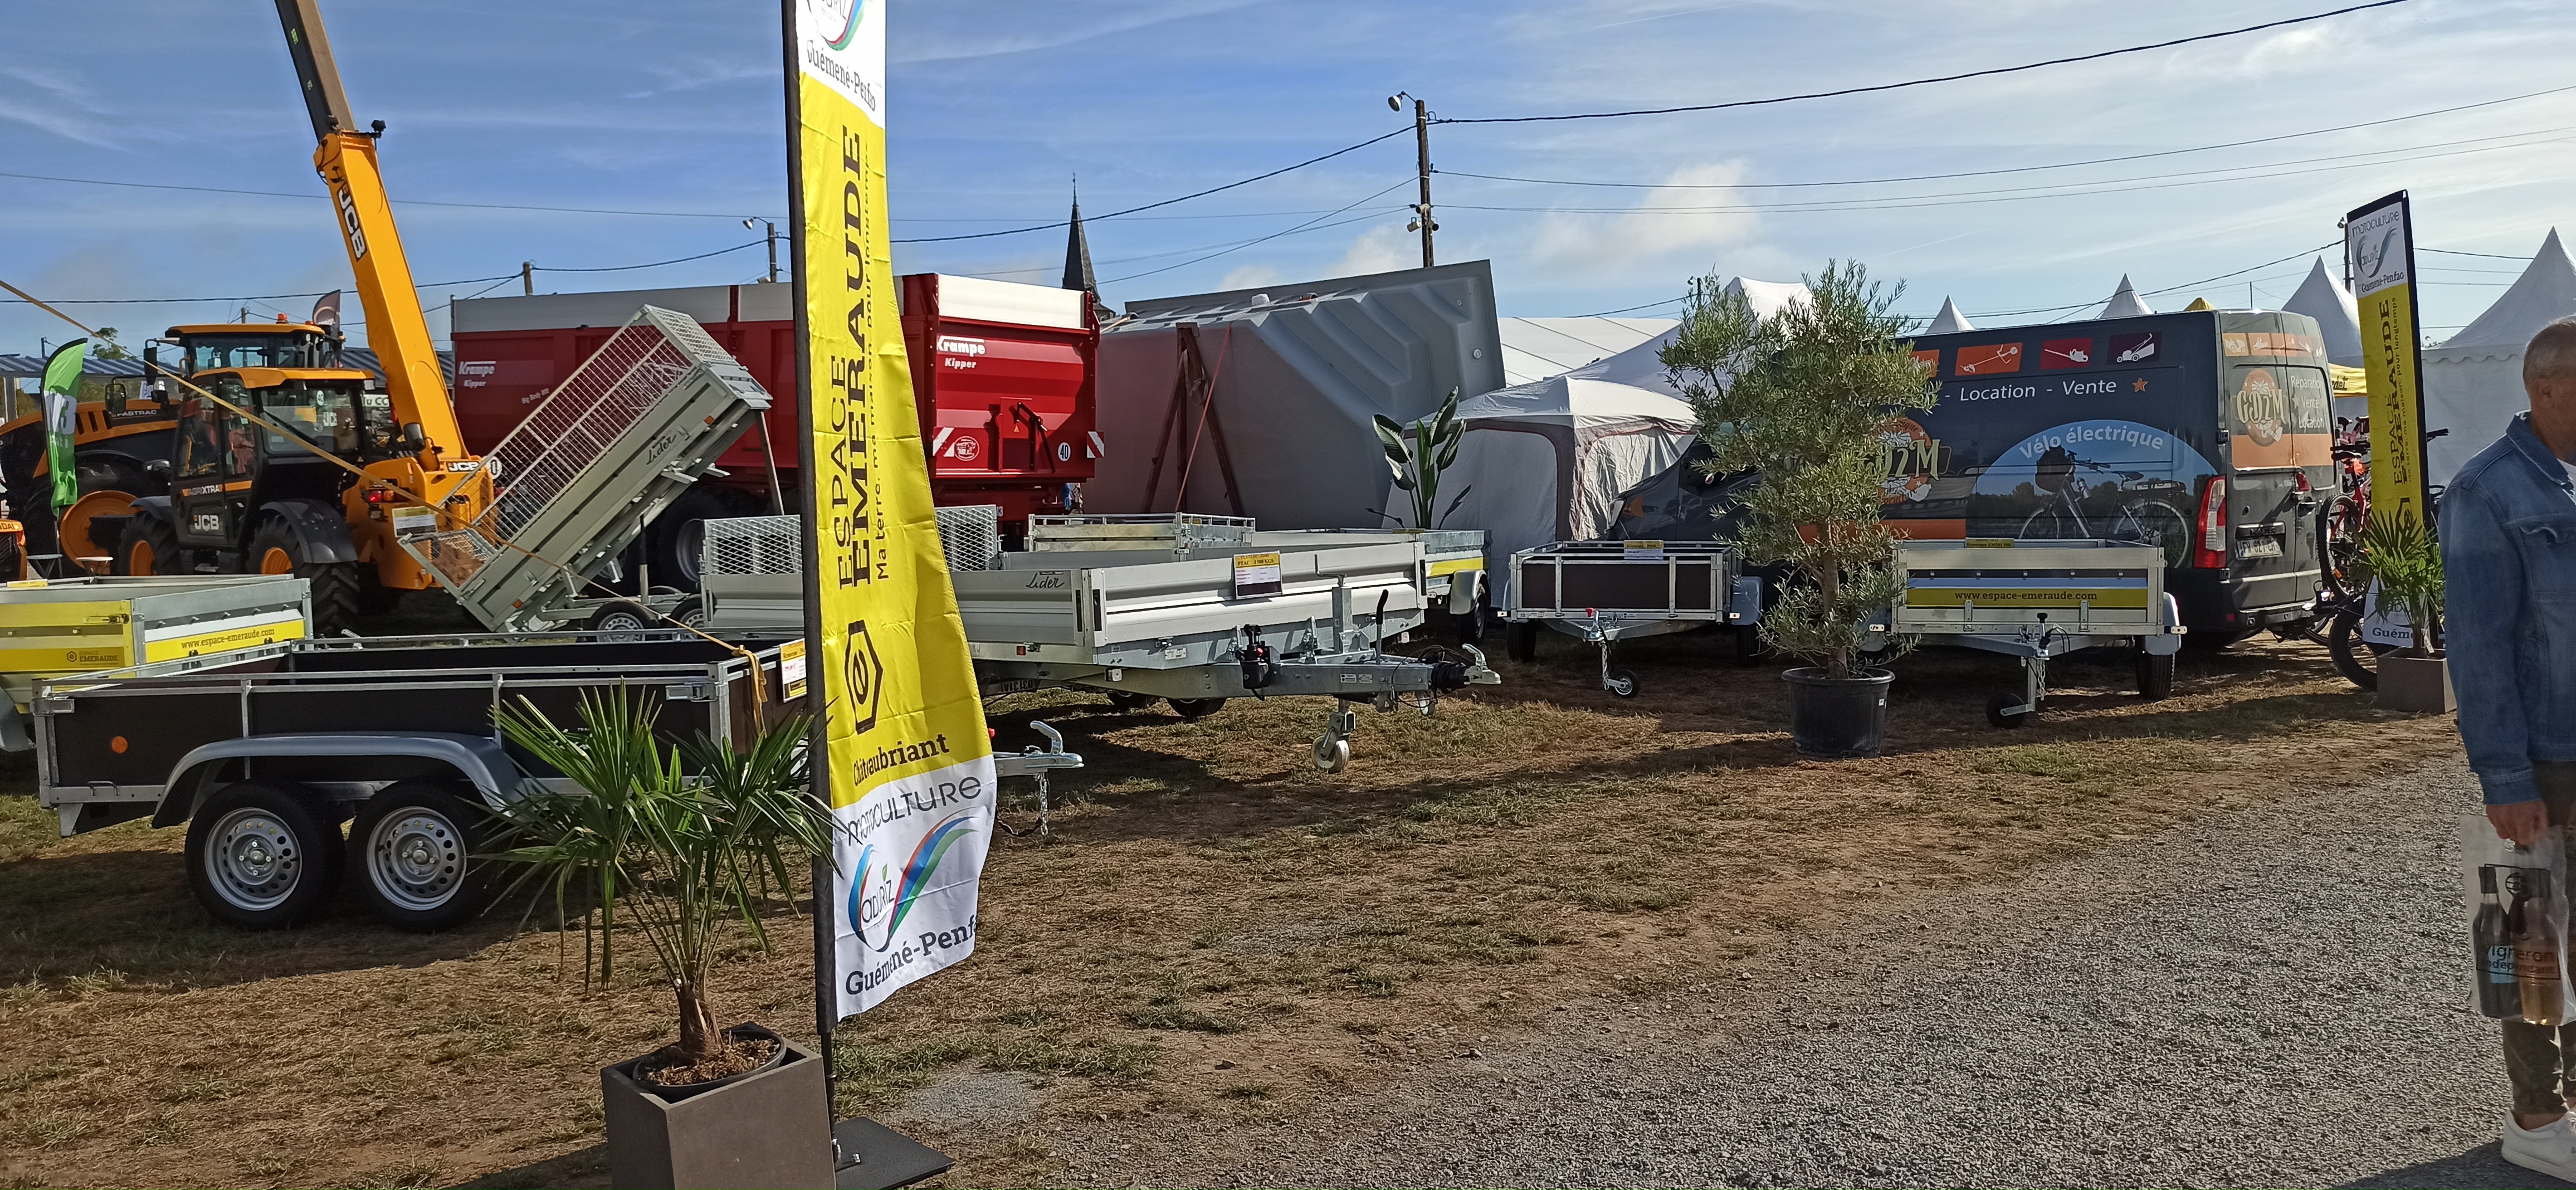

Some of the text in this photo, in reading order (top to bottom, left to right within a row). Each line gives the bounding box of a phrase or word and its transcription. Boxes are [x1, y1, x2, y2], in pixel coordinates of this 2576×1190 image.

[339, 188, 366, 259] JCB
[936, 335, 985, 357] Krampe
[842, 125, 870, 587] EMERAUDE
[945, 358, 977, 369] Kipper
[458, 361, 496, 377] Krampe
[464, 379, 486, 388] Kipper
[1960, 384, 2035, 401] Location
[2063, 379, 2117, 396] Vente
[2291, 375, 2324, 391] Réparation
[2301, 396, 2319, 409] Vente
[2299, 416, 2325, 428] Location
[2019, 425, 2163, 459] Vélo électrique
[1060, 445, 1069, 460] 40
[448, 461, 480, 472] JCB
[831, 355, 853, 589] ESPACE
[189, 484, 220, 496] AGRIXTRA
[194, 515, 219, 531] JCB
[876, 548, 889, 580] Ma
[1026, 572, 1065, 589] Lider
[1954, 592, 2097, 601] www.espace-emeraude.com
[181, 628, 275, 648] www.espace-emeraude.com
